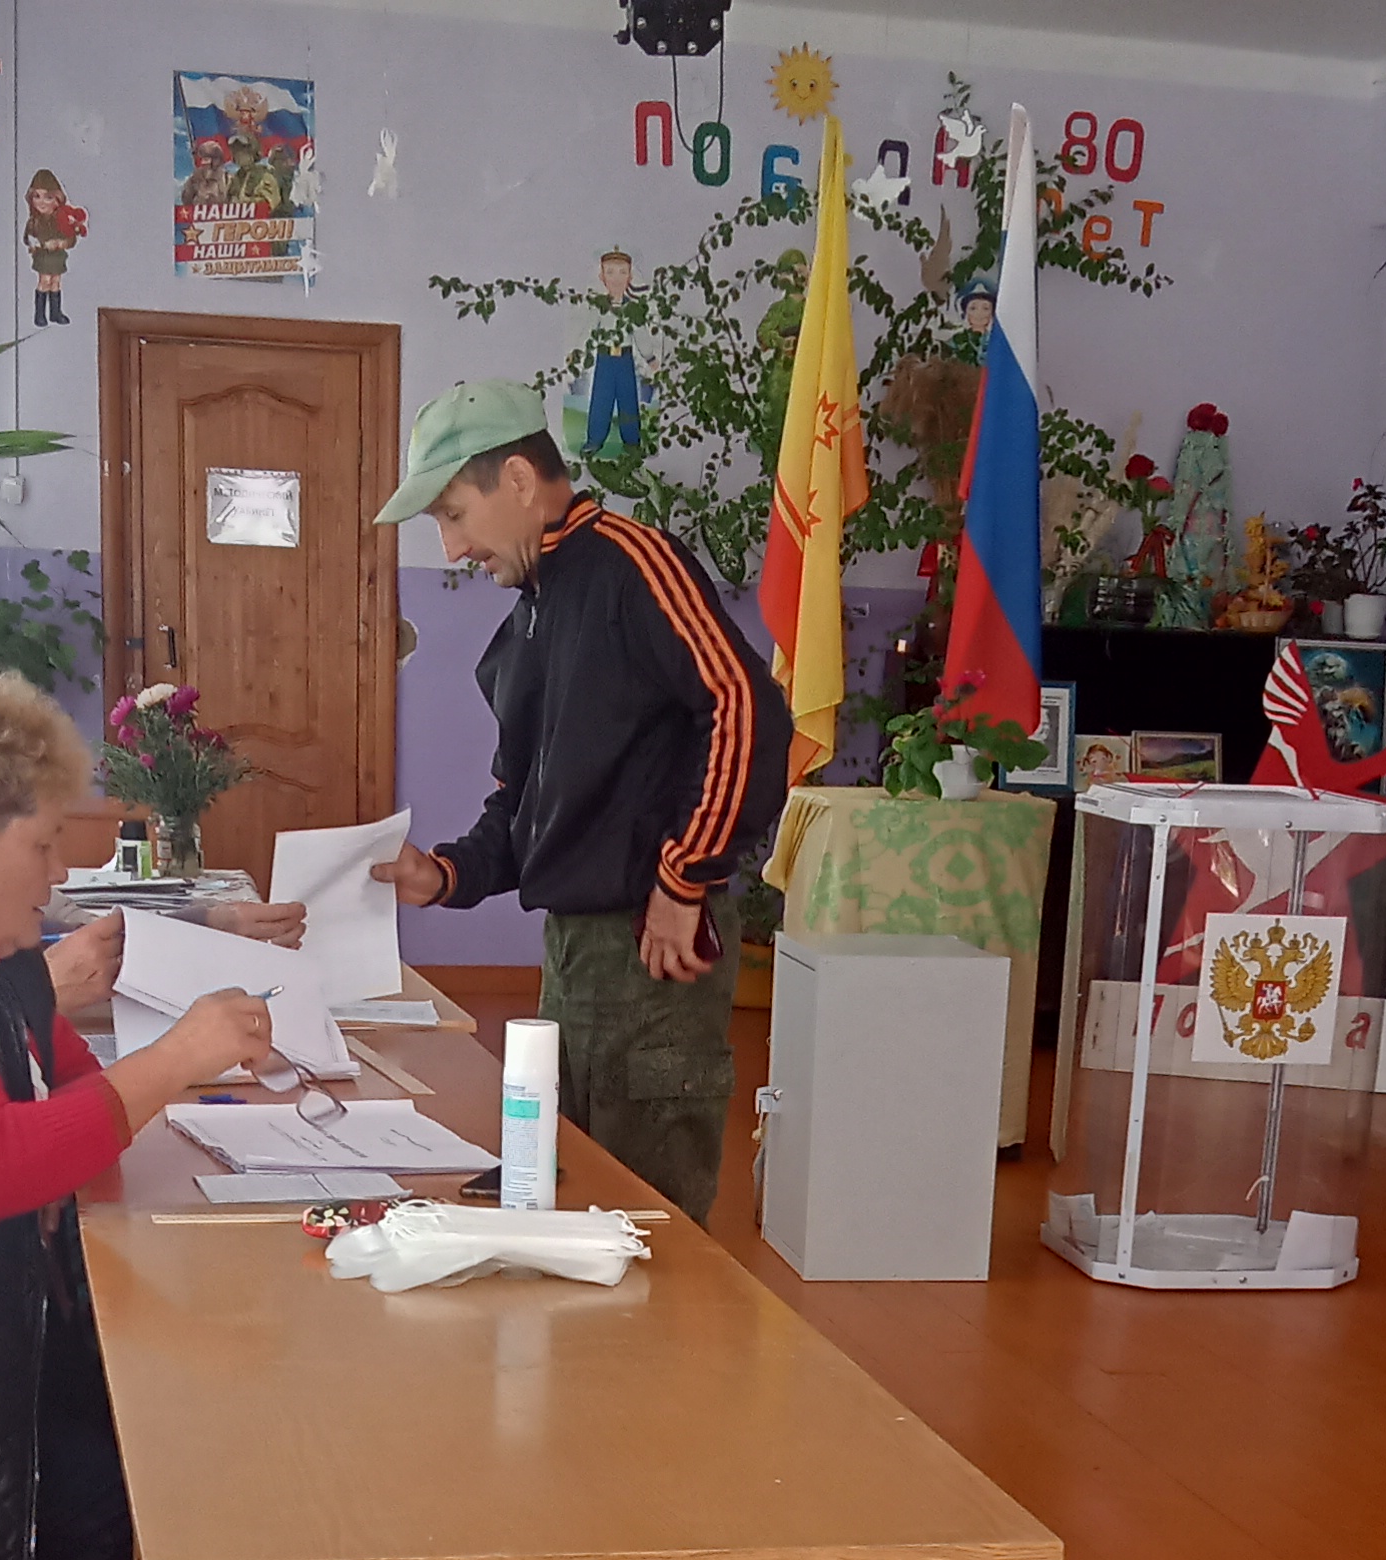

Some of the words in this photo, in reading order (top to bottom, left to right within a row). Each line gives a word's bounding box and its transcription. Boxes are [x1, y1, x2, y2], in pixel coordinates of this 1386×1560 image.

[1061, 111, 1144, 183] 80
[194, 203, 256, 220] НАШИ
[212, 220, 294, 242] ГЕРОИ!
[194, 243, 246, 259] НАШИ
